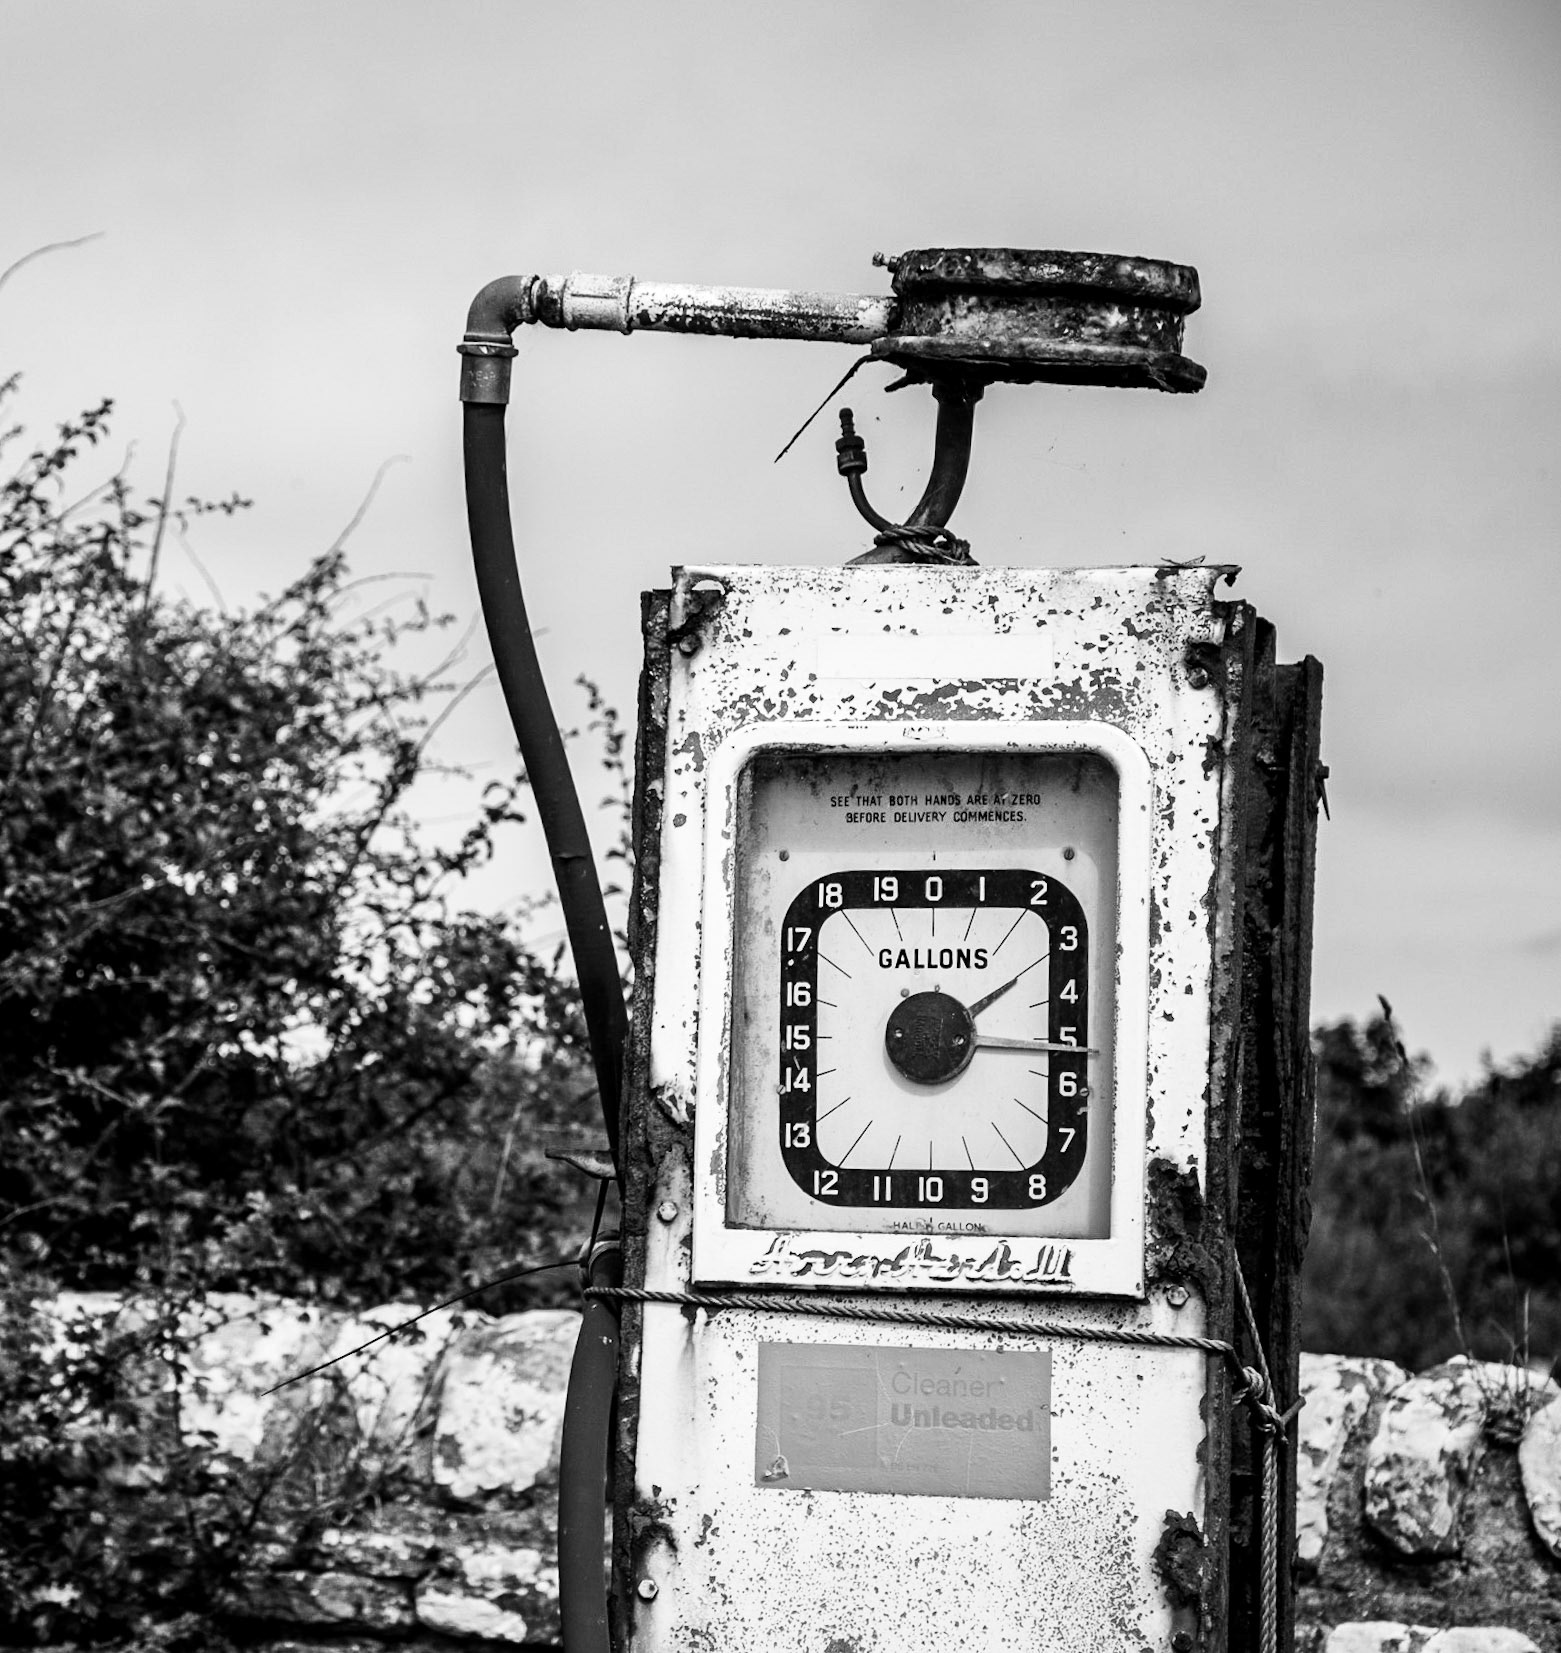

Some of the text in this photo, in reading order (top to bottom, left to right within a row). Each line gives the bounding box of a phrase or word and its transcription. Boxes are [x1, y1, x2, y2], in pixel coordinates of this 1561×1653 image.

[830, 793, 1041, 808] SEE THAT BOTH HANDS ARE AT ZERO
[845, 810, 1027, 823] BEFORE DELIVERY COMMENCES.
[819, 883, 843, 908] 18
[874, 877, 899, 902] 19
[925, 877, 943, 902] 0
[1030, 881, 1048, 906] 2
[787, 927, 812, 952] 17
[1059, 926, 1078, 951] 3
[878, 948, 988, 970] GALLONS
[786, 981, 812, 1007] 16
[1059, 979, 1079, 1004] 4
[785, 1025, 811, 1050] 15
[1060, 1026, 1078, 1049] 5
[784, 1067, 811, 1093] 14
[1059, 1072, 1077, 1097] 6
[785, 1122, 811, 1148] 13
[1058, 1128, 1076, 1153] 7
[813, 1170, 839, 1196] 12
[873, 1176, 892, 1202] 11
[918, 1176, 943, 1202] 10
[970, 1177, 989, 1203] 9
[1028, 1174, 1047, 1200] 8
[891, 1371, 999, 1398] Cleaner
[891, 1403, 1034, 1432] Unleaded
